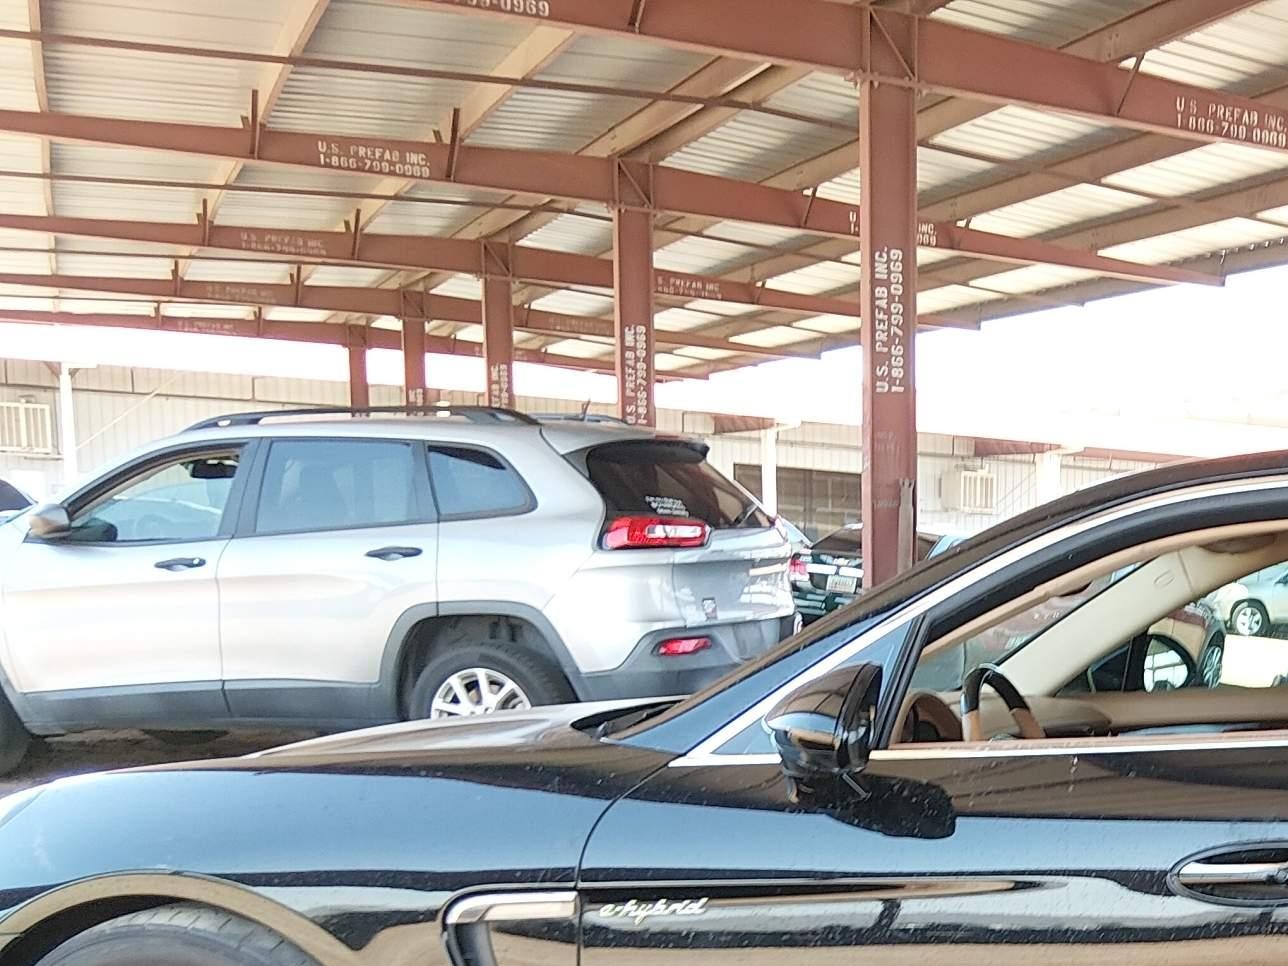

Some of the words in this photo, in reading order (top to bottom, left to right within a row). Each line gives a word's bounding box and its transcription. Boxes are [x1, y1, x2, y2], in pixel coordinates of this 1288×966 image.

[458, 0, 550, 17] -0969
[1208, 103, 1258, 127] PREFAB
[350, 145, 400, 162] PREFAB
[406, 151, 431, 166] INC.
[875, 246, 888, 280] INC.
[875, 286, 889, 353] PREFAB
[890, 248, 905, 393] 1-866-799-0969
[625, 350, 636, 398] PREFAB
[876, 361, 889, 393] U.S.
